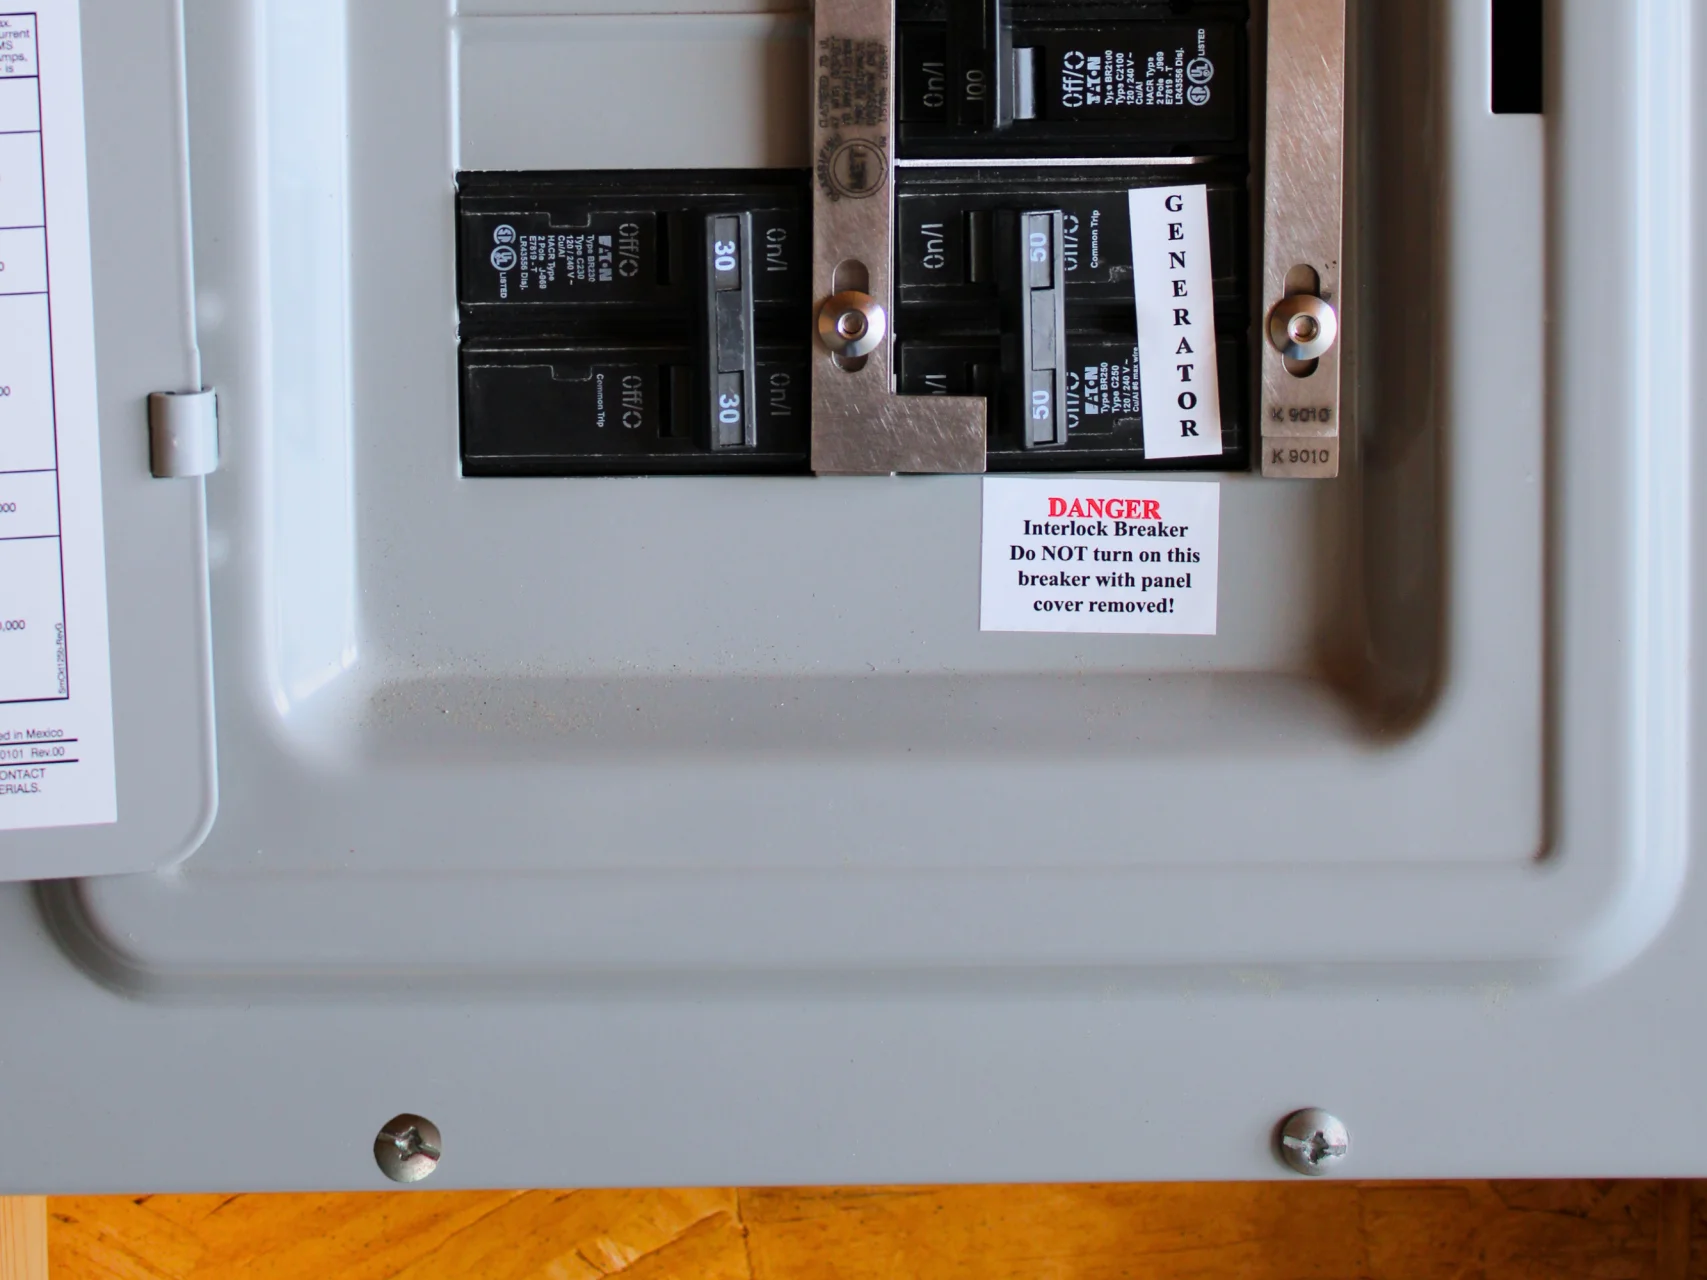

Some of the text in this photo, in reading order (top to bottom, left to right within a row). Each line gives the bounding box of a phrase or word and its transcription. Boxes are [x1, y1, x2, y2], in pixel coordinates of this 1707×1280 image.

[1104, 50, 1113, 82] BR2100
[1115, 52, 1125, 105] Type C2100
[1126, 90, 1134, 105] 120
[1146, 79, 1154, 105] HACR
[1165, 79, 1173, 105] E7819
[1175, 68, 1183, 105] LR43556
[529, 235, 537, 260] E7819
[566, 235, 574, 249] 120
[585, 235, 595, 254] Type
[1030, 232, 1047, 262] 50
[1090, 210, 1101, 268] Common Trip
[519, 236, 528, 270] LR43556
[575, 235, 584, 280] Type C230
[598, 235, 612, 281] EATON
[714, 240, 736, 271] 30
[1164, 193, 1200, 438] GENERATOR
[596, 374, 604, 410] Common
[1084, 367, 1099, 415] EATON
[1112, 365, 1121, 413] Type C250
[719, 394, 740, 424] 30
[1032, 390, 1050, 420] 50
[1101, 392, 1110, 414] Type
[1123, 398, 1131, 413] 120
[1289, 408, 1331, 422] 9010
[1272, 449, 1329, 464] K 9010
[1048, 497, 1162, 520] DANGER
[1024, 520, 1189, 538] Interlock Breaker
[1010, 545, 1200, 563] Do NOT turn on this
[1018, 570, 1192, 592] breaker with panel
[1033, 598, 1174, 614] cover removed!
[13, 728, 64, 740] in Mexico
[31, 746, 65, 758] Rev.00
